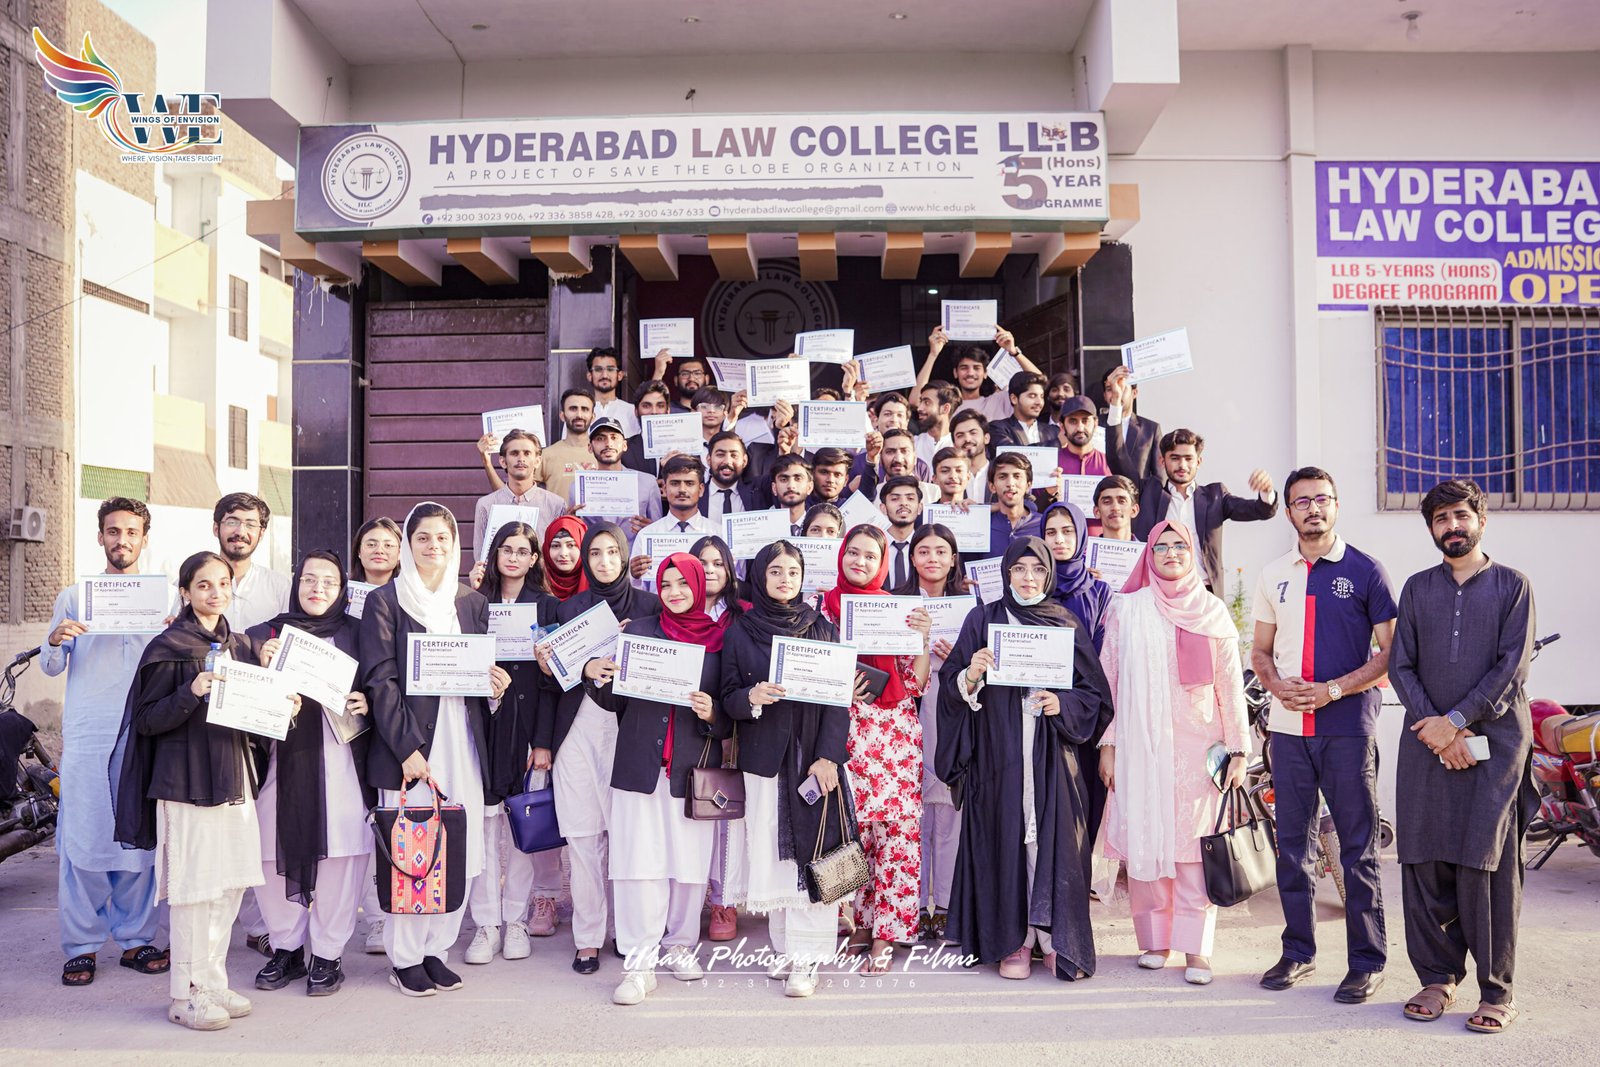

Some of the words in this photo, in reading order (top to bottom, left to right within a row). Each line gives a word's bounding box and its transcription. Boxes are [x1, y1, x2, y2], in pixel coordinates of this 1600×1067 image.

[429, 129, 677, 165] HYDERABAD
[692, 127, 777, 158] LAW
[790, 124, 978, 157] COLLEGE
[331, 143, 361, 185] HYDERABAD
[384, 147, 403, 181] COLLEGE
[1047, 155, 1101, 170] (Hons)
[446, 171, 455, 180] A
[470, 168, 558, 180] PROJECT
[573, 167, 595, 178] OF
[610, 165, 659, 178] SAVE
[674, 164, 710, 175] THE
[724, 162, 790, 174] GLOBE
[804, 161, 961, 174] ORGANIZATION
[1001, 156, 1048, 210] 5
[1052, 174, 1102, 187] YEAR
[723, 203, 884, 215] hyderabadlawcollege@gmail.com
[899, 203, 976, 214] www.hlc.edu.pk
[1016, 198, 1103, 208] PROGRAMME
[437, 214, 453, 222] +92
[456, 213, 475, 222] 300
[479, 213, 501, 221] 3023
[504, 212, 526, 221] 906,
[528, 212, 545, 220] +92
[548, 212, 566, 220] 336
[569, 211, 593, 219] 3858
[595, 210, 616, 219] 428,
[619, 210, 635, 218] +92
[638, 209, 658, 217] 300
[660, 208, 684, 216] 4367
[686, 208, 704, 216] 633
[1329, 209, 1421, 242] LAW
[1434, 209, 1600, 243] COLLEG
[766, 272, 793, 284] LAW
[1331, 263, 1360, 277] LLB
[1366, 263, 1434, 278] 5-YEARS
[1332, 283, 1401, 300] DEGREE
[1407, 284, 1498, 301] PROGRAM
[1509, 273, 1600, 304] OPE
[1099, 544, 1138, 553] CERTIFICATE
[977, 563, 1001, 571] CERTIFI
[1277, 580, 1289, 603] 7
[551, 619, 590, 646] CERTIFICATE
[1002, 631, 1048, 640] CERTIFICATE
[295, 636, 336, 661] CERTIFICATE
[631, 643, 677, 655] CERTIFICATE
[786, 644, 832, 656] CERTIFICATE
[228, 668, 273, 684] CERTIFICATE
